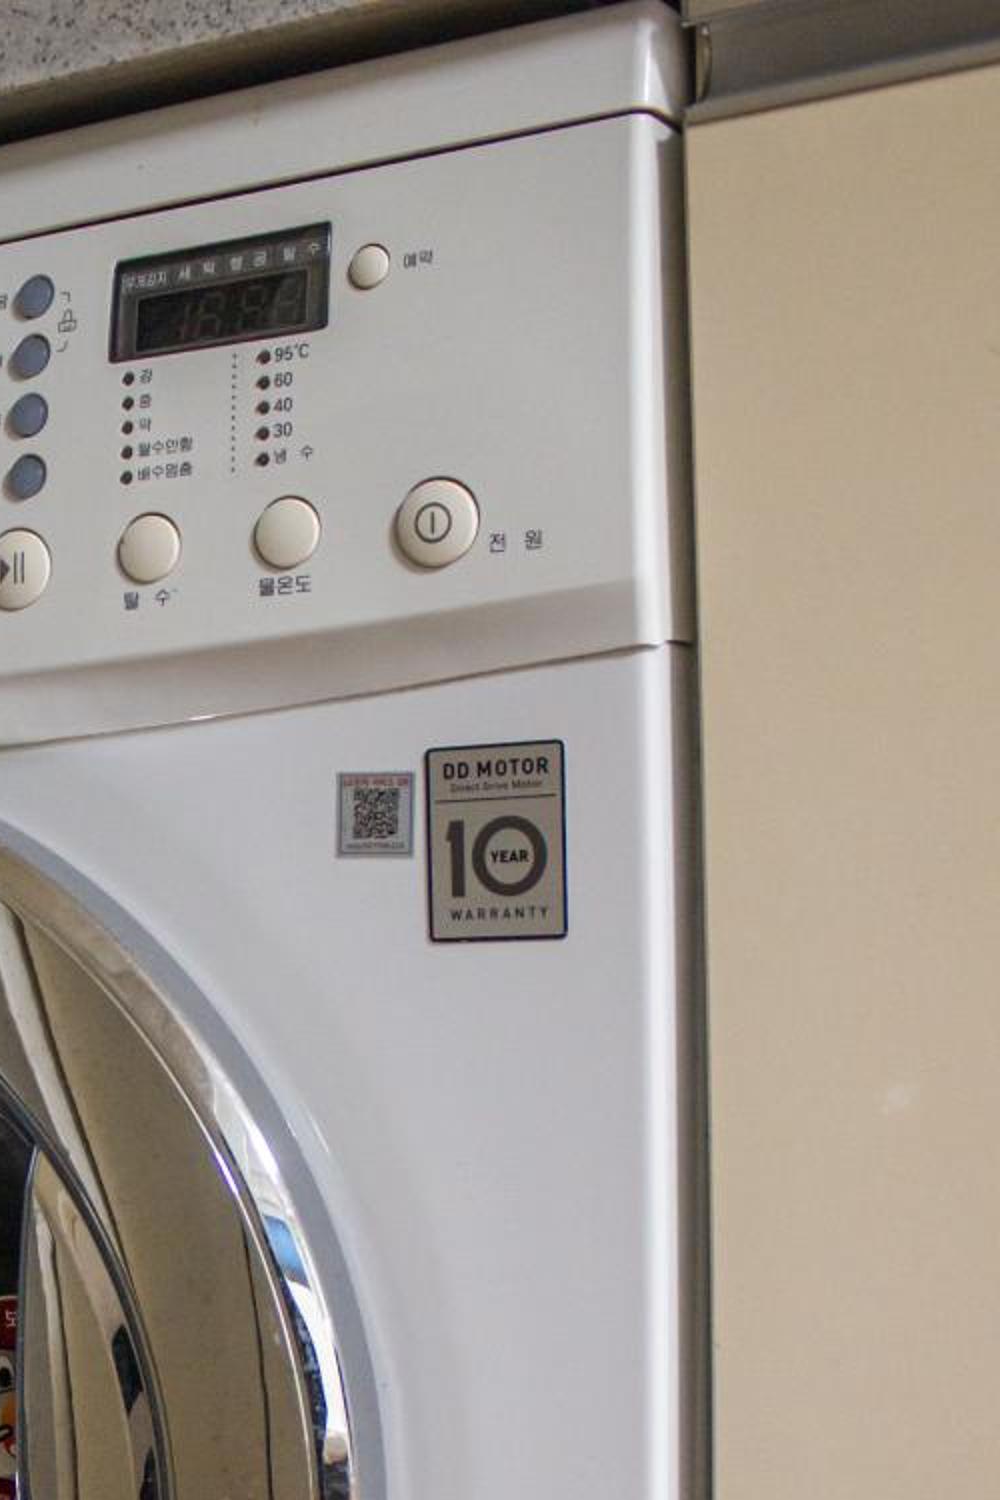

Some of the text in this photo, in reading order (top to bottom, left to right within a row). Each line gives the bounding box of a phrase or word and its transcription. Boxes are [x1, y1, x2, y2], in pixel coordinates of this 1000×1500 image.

[274, 372, 293, 387] 60
[273, 397, 293, 412] 40
[273, 422, 293, 437] 30
[489, 528, 543, 553] 전원
[258, 575, 311, 597] 물온도
[443, 756, 549, 780] DD MOTOR
[445, 816, 547, 897] 10
[491, 849, 528, 863] YEAR
[451, 905, 548, 921] WARRANTY
